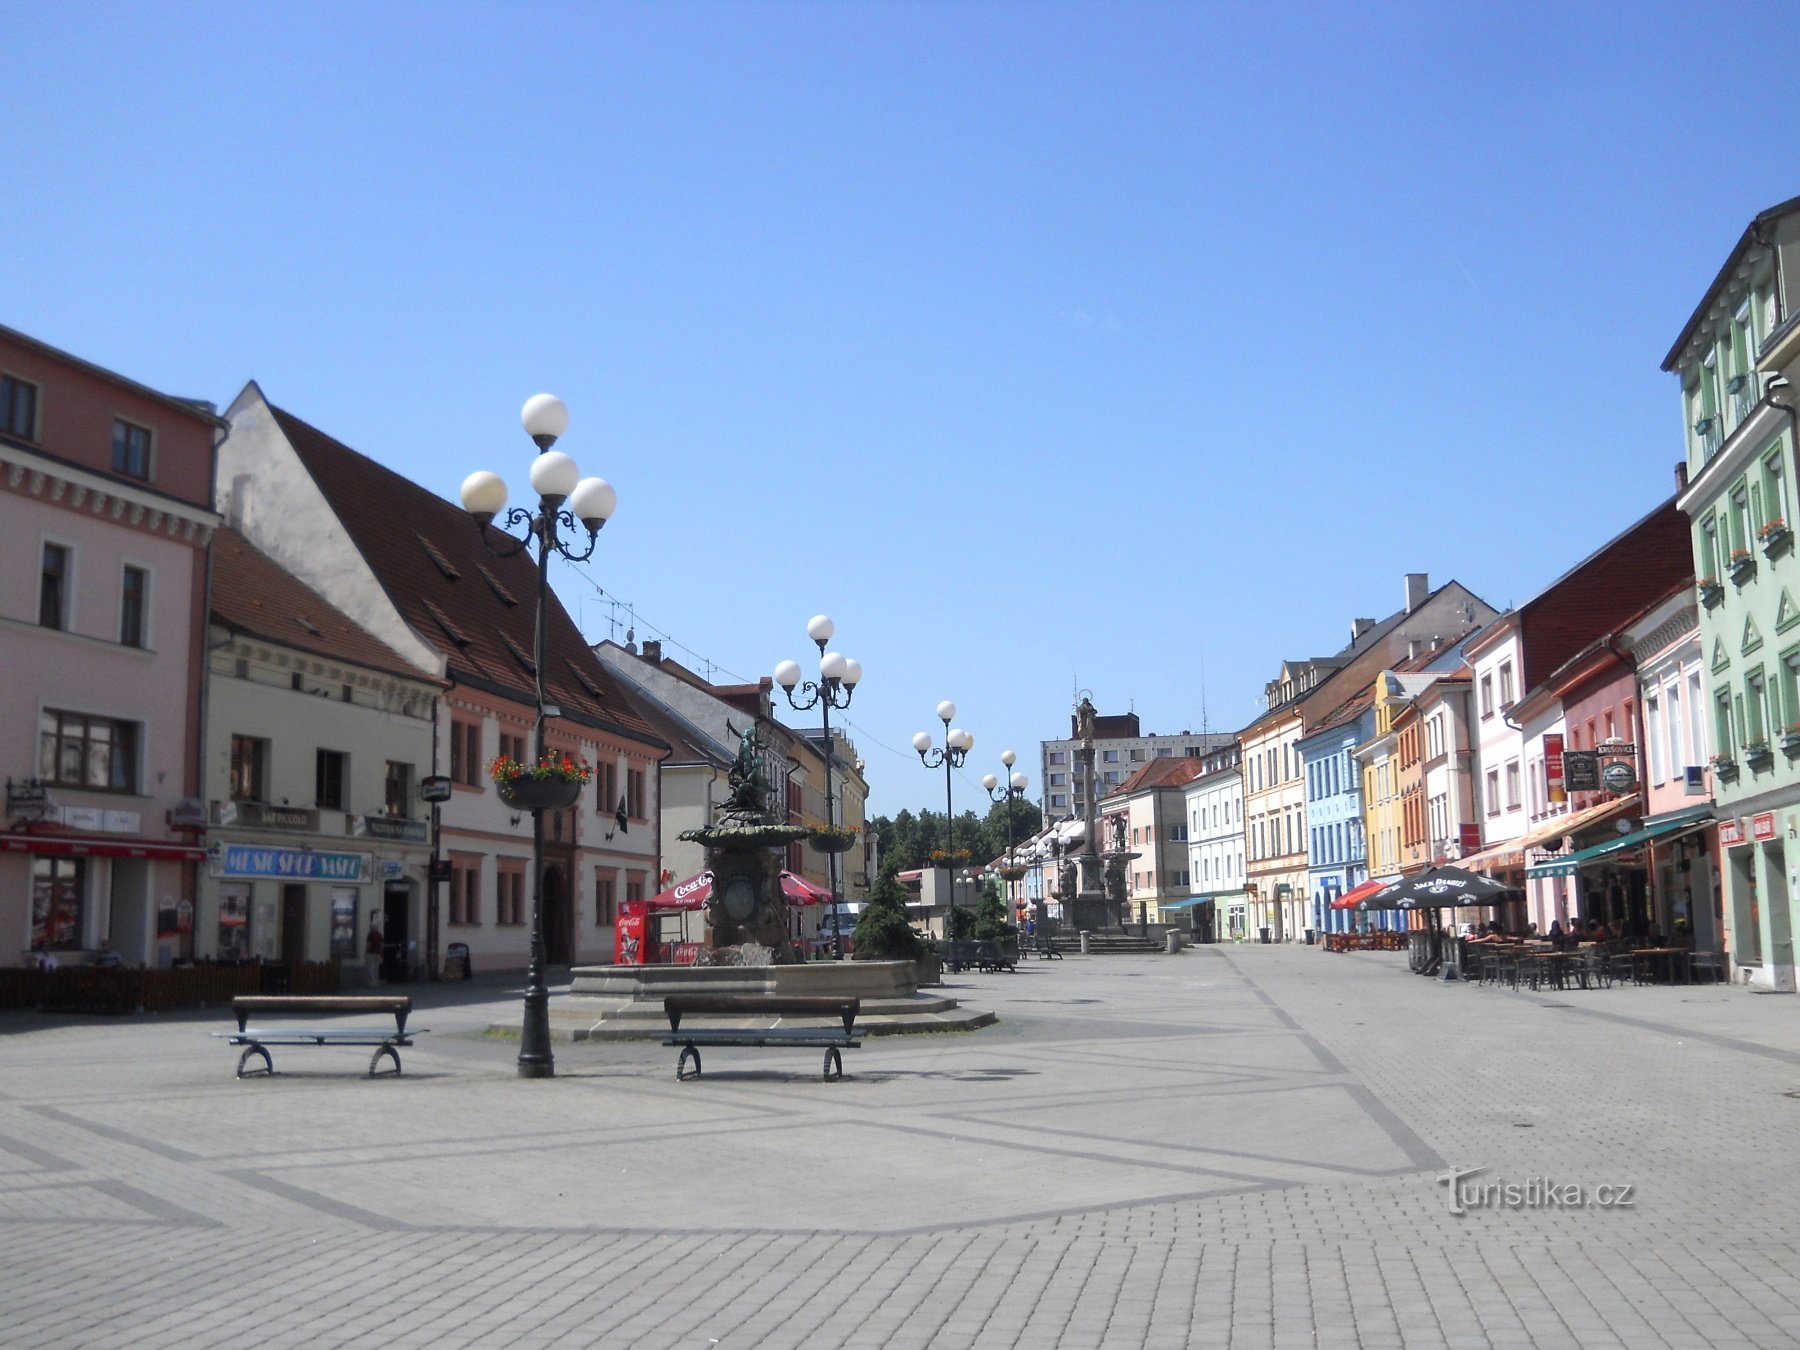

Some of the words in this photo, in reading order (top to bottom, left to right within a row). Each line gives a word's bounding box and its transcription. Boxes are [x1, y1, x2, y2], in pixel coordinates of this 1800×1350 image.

[229, 851, 274, 873] MUSIC
[278, 853, 317, 876] SHOP
[674, 873, 713, 899] Coca-Co
[1413, 881, 1434, 891] JACK
